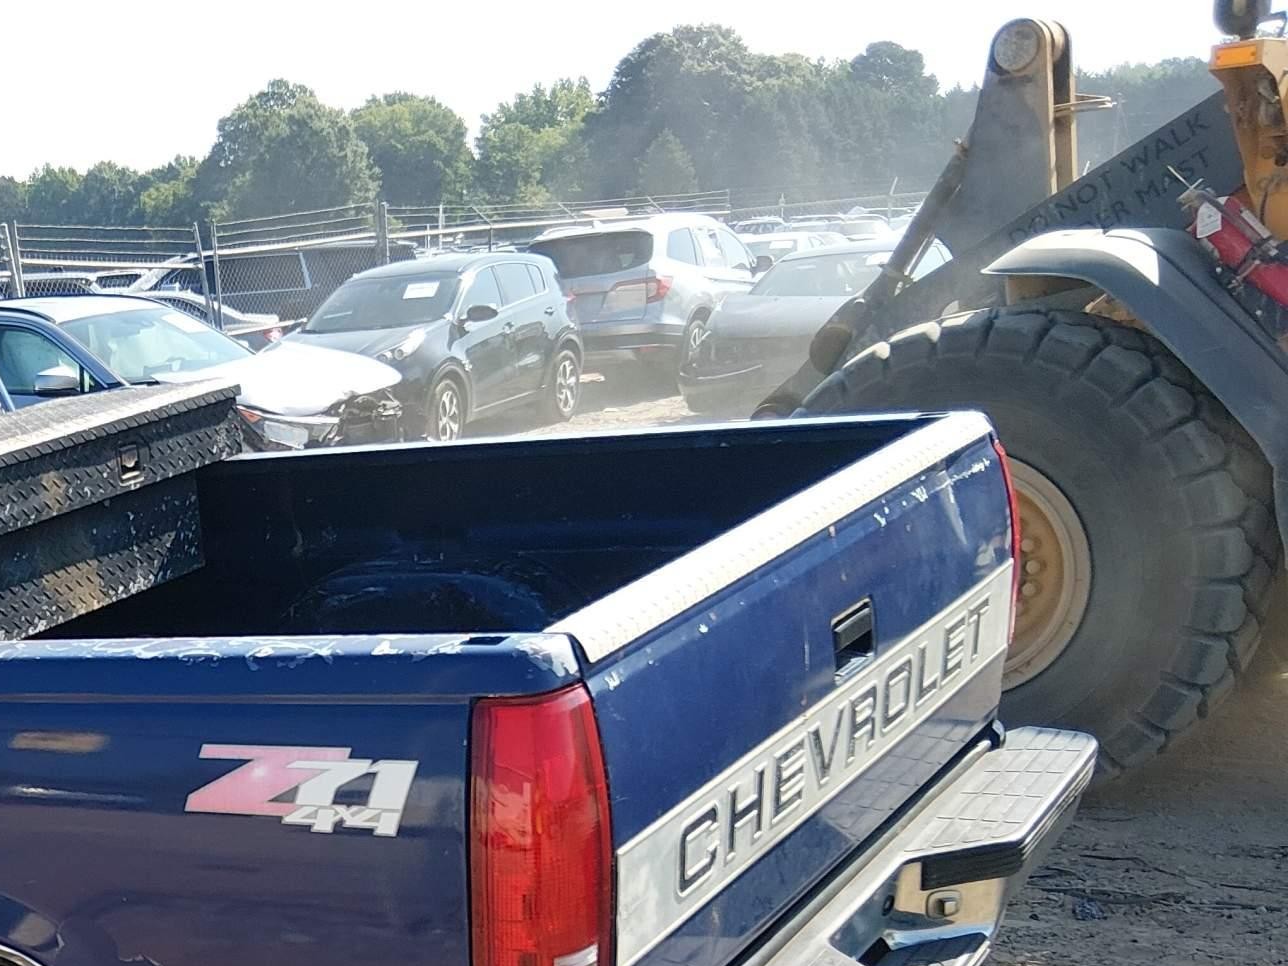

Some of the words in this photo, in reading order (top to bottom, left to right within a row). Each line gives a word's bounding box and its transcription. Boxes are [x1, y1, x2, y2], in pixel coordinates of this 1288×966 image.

[1054, 168, 1112, 220] NOT
[1120, 111, 1211, 174] WALK
[1134, 146, 1211, 206] MAST
[184, 744, 419, 816] Z71
[677, 594, 991, 898] CHEVROLET
